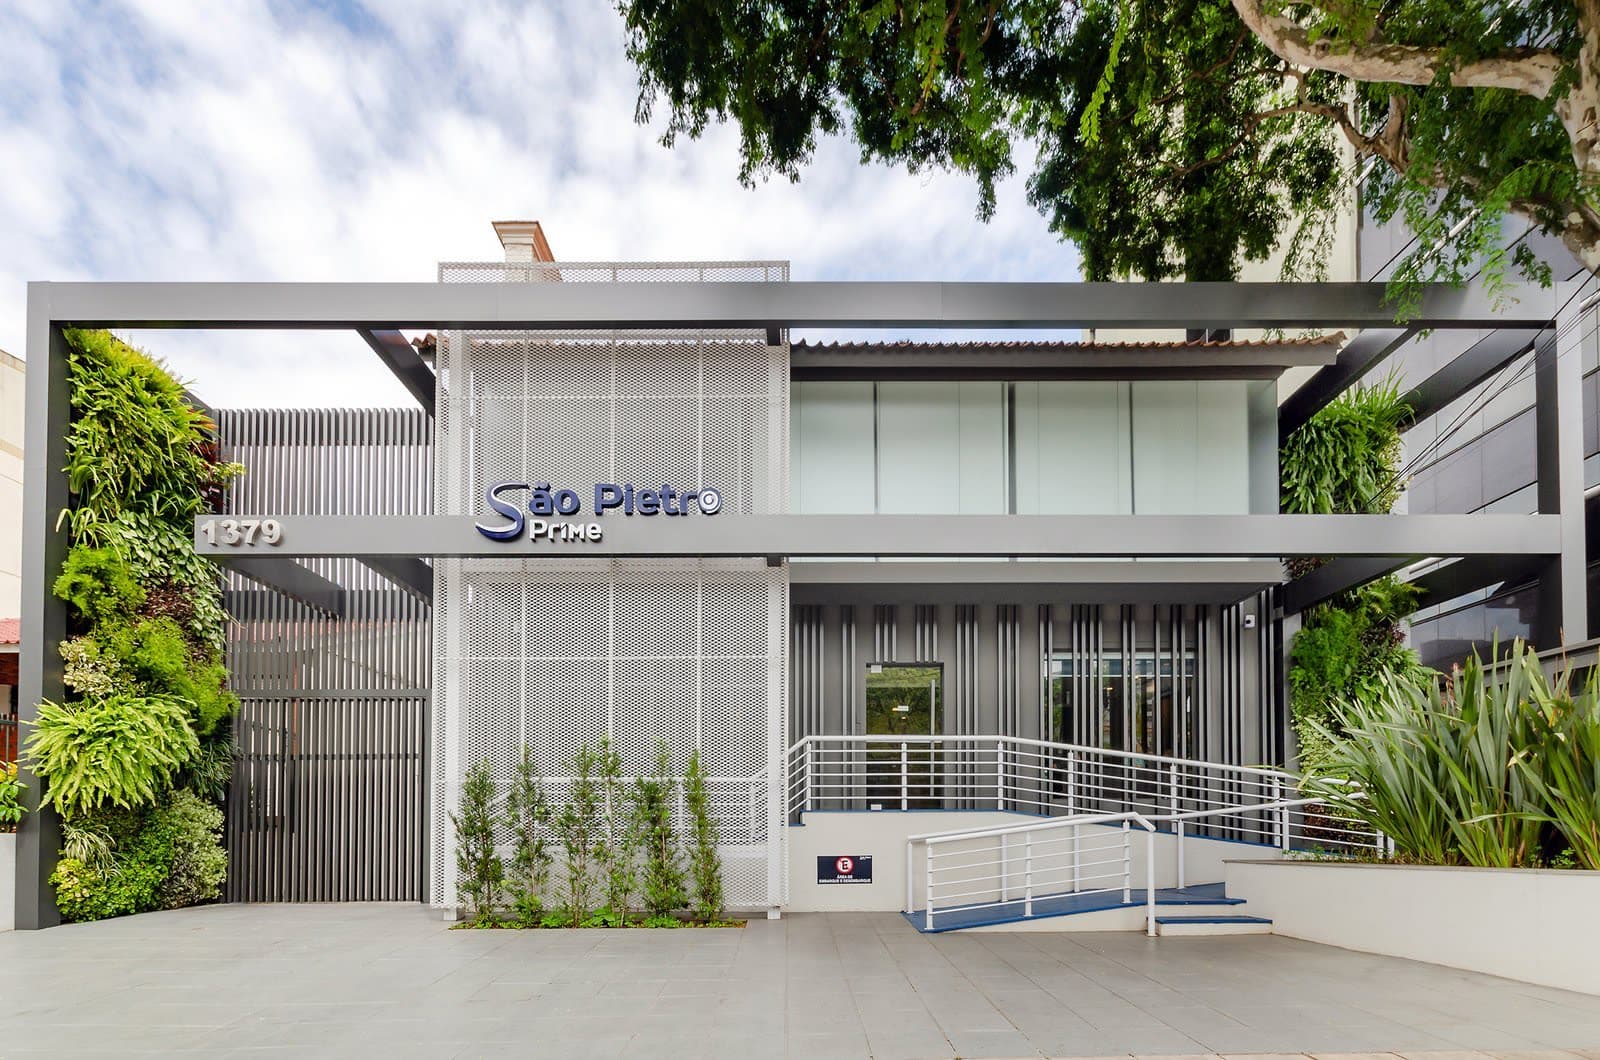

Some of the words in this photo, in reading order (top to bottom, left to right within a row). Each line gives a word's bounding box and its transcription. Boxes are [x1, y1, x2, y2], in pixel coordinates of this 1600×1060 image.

[201, 519, 283, 545] 1379
[475, 480, 581, 542] São
[594, 482, 722, 516] Pietro
